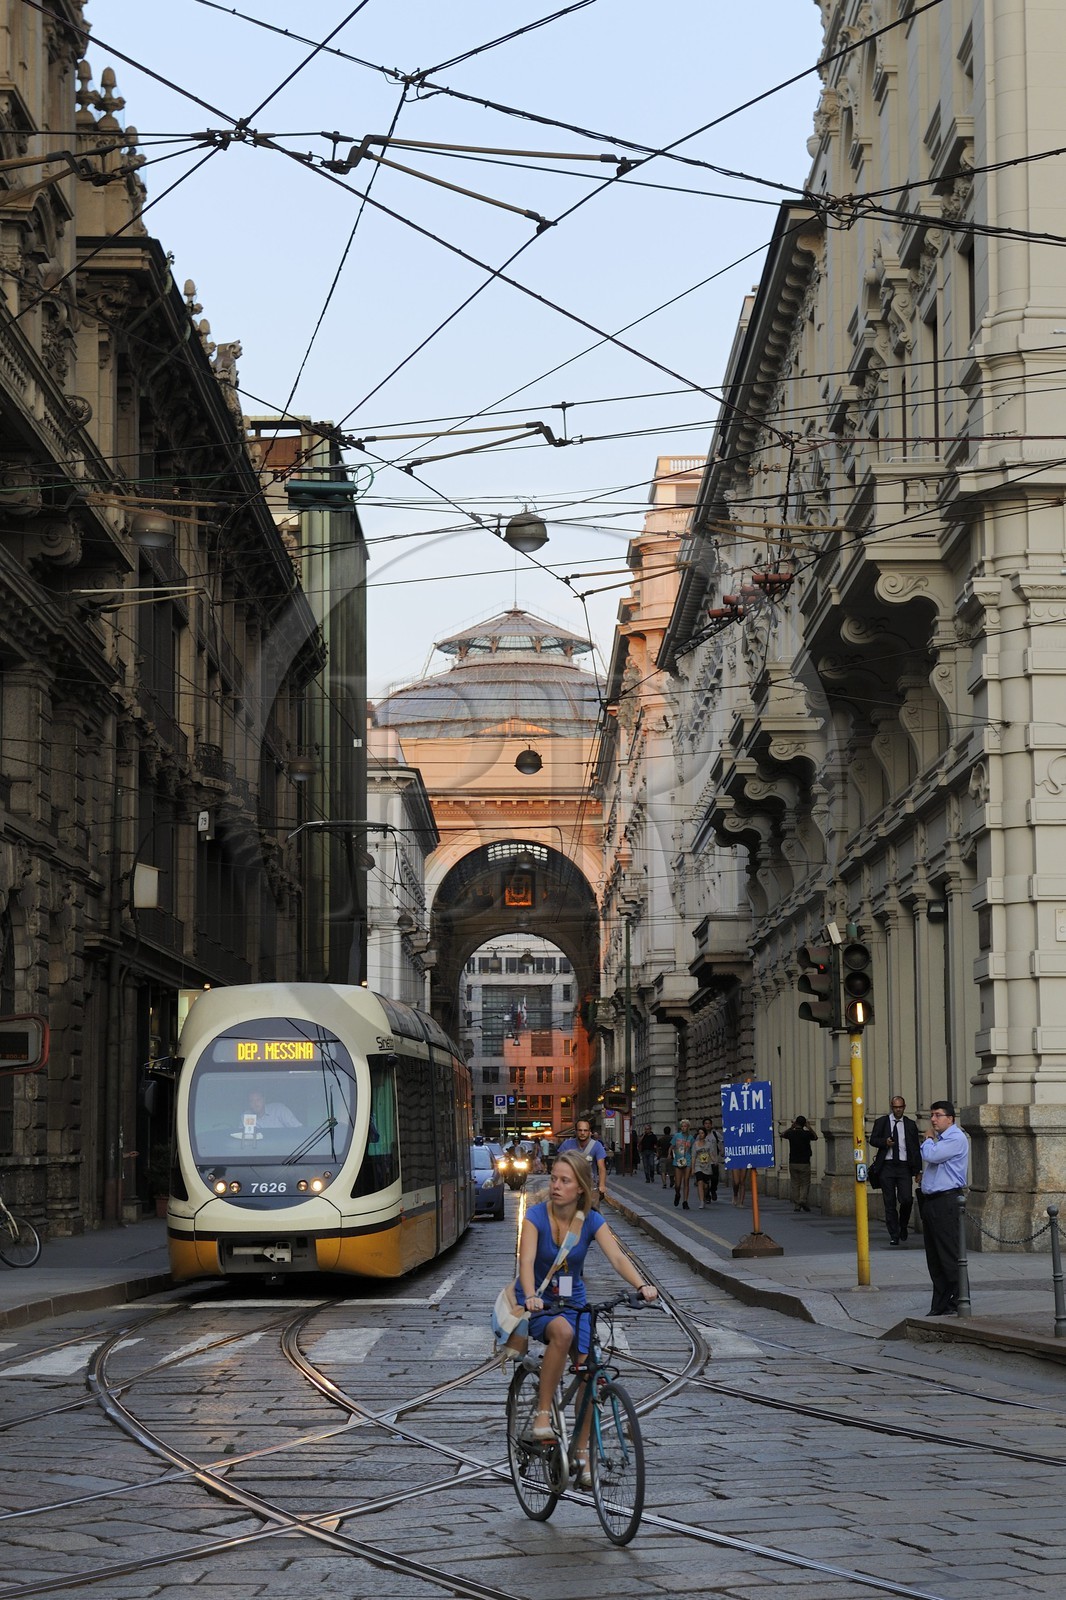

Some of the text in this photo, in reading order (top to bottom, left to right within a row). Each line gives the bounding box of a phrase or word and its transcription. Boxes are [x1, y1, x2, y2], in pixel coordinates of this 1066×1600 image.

[201, 817, 207, 826] 79
[237, 1041, 314, 1060] DEP. MESSINA
[740, 1122, 755, 1133] FINE
[724, 1144, 773, 1157] RALLENTAMENTO
[251, 1182, 287, 1194] 7626
